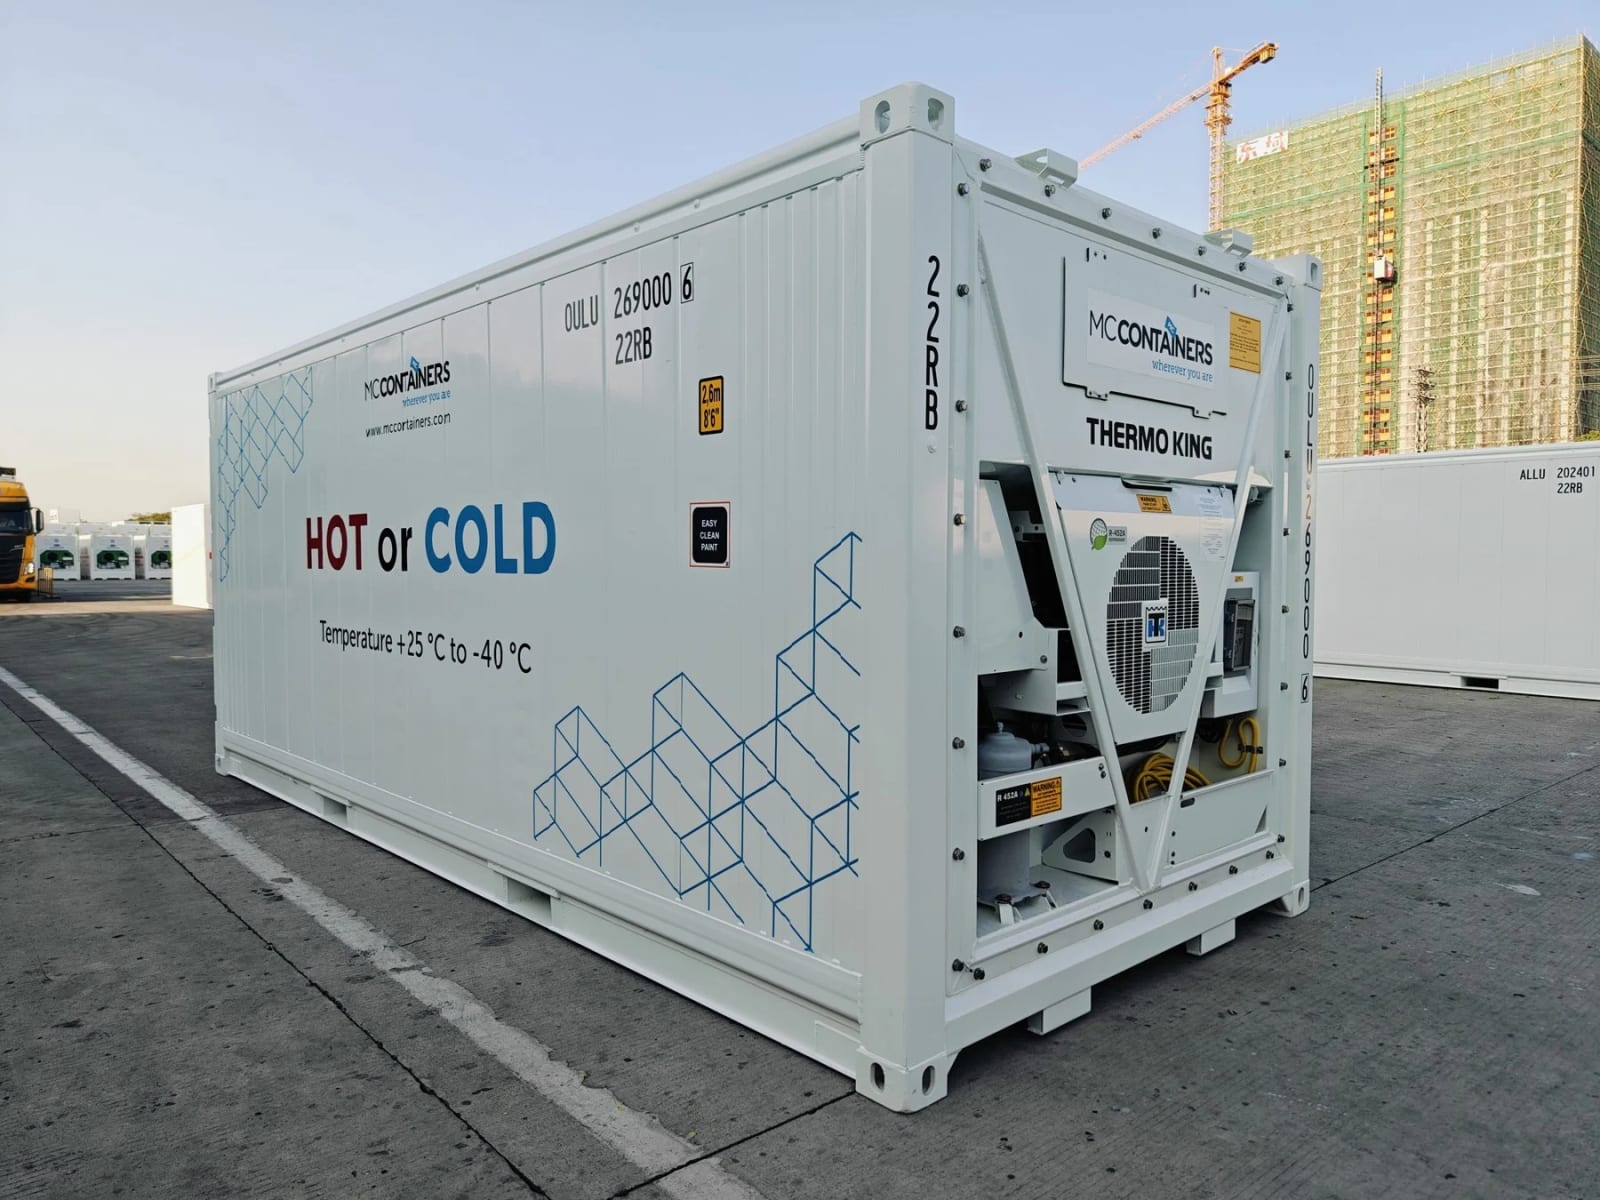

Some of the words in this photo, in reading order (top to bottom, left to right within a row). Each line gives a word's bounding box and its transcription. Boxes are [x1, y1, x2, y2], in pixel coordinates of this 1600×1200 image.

[565, 295, 599, 332] OULU
[614, 272, 672, 319] 269000
[682, 266, 692, 300] 6
[615, 327, 652, 365] 22RB
[925, 255, 940, 430] 22RB
[1089, 310, 1213, 366] MCCONTAINERS
[1152, 359, 1186, 377] wherever
[1187, 367, 1201, 380] you
[1201, 373, 1213, 383] are
[428, 391, 440, 404] you
[1086, 417, 1169, 455] THERMO
[1172, 431, 1213, 461] KING
[1520, 468, 1546, 480] ALLU
[1557, 466, 1595, 478] 202401
[1557, 482, 1583, 494] 22RB
[306, 513, 368, 571] HOT
[377, 527, 413, 573] or
[425, 501, 556, 575] COLD
[700, 531, 720, 540] CLEAN
[701, 519, 718, 528] EASY
[700, 543, 719, 551] PAINT
[1302, 494, 1312, 659] 269000
[319, 619, 393, 655] Temperature
[396, 630, 424, 658] +25
[427, 633, 446, 661] °C
[450, 638, 467, 665] to
[473, 639, 503, 670] -40
[509, 641, 532, 674] °C
